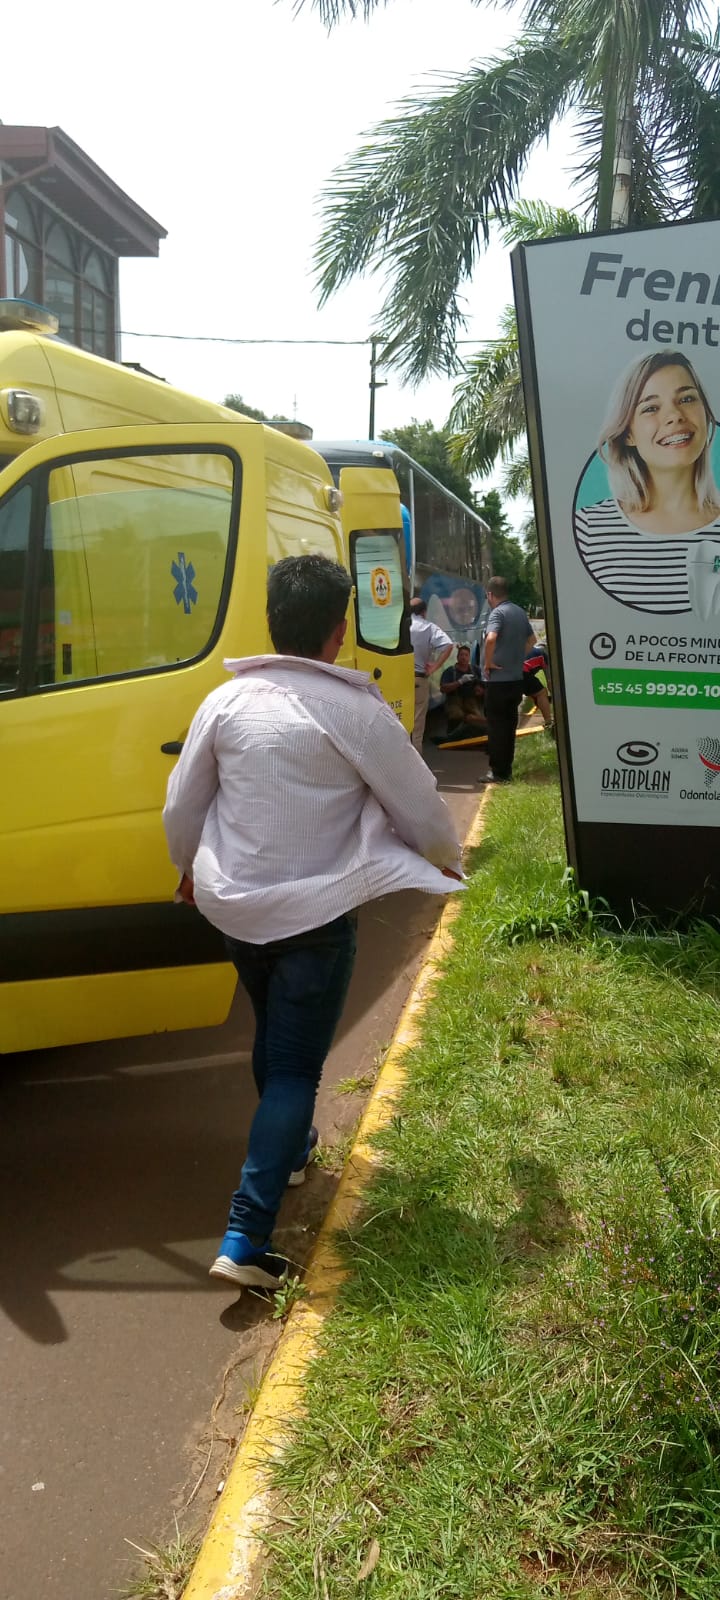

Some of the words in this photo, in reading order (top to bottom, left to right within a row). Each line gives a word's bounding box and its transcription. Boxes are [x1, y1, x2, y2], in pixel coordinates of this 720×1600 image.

[625, 308, 720, 347] dent
[626, 635, 636, 645] A
[639, 635, 687, 648] POCOS
[690, 637, 720, 649] MIN
[625, 650, 644, 662] DE
[647, 652, 665, 662] LA
[599, 682, 623, 694] +55
[625, 684, 643, 694] 45
[646, 682, 720, 698] 99920-10
[601, 768, 671, 792] ORTOPLAN
